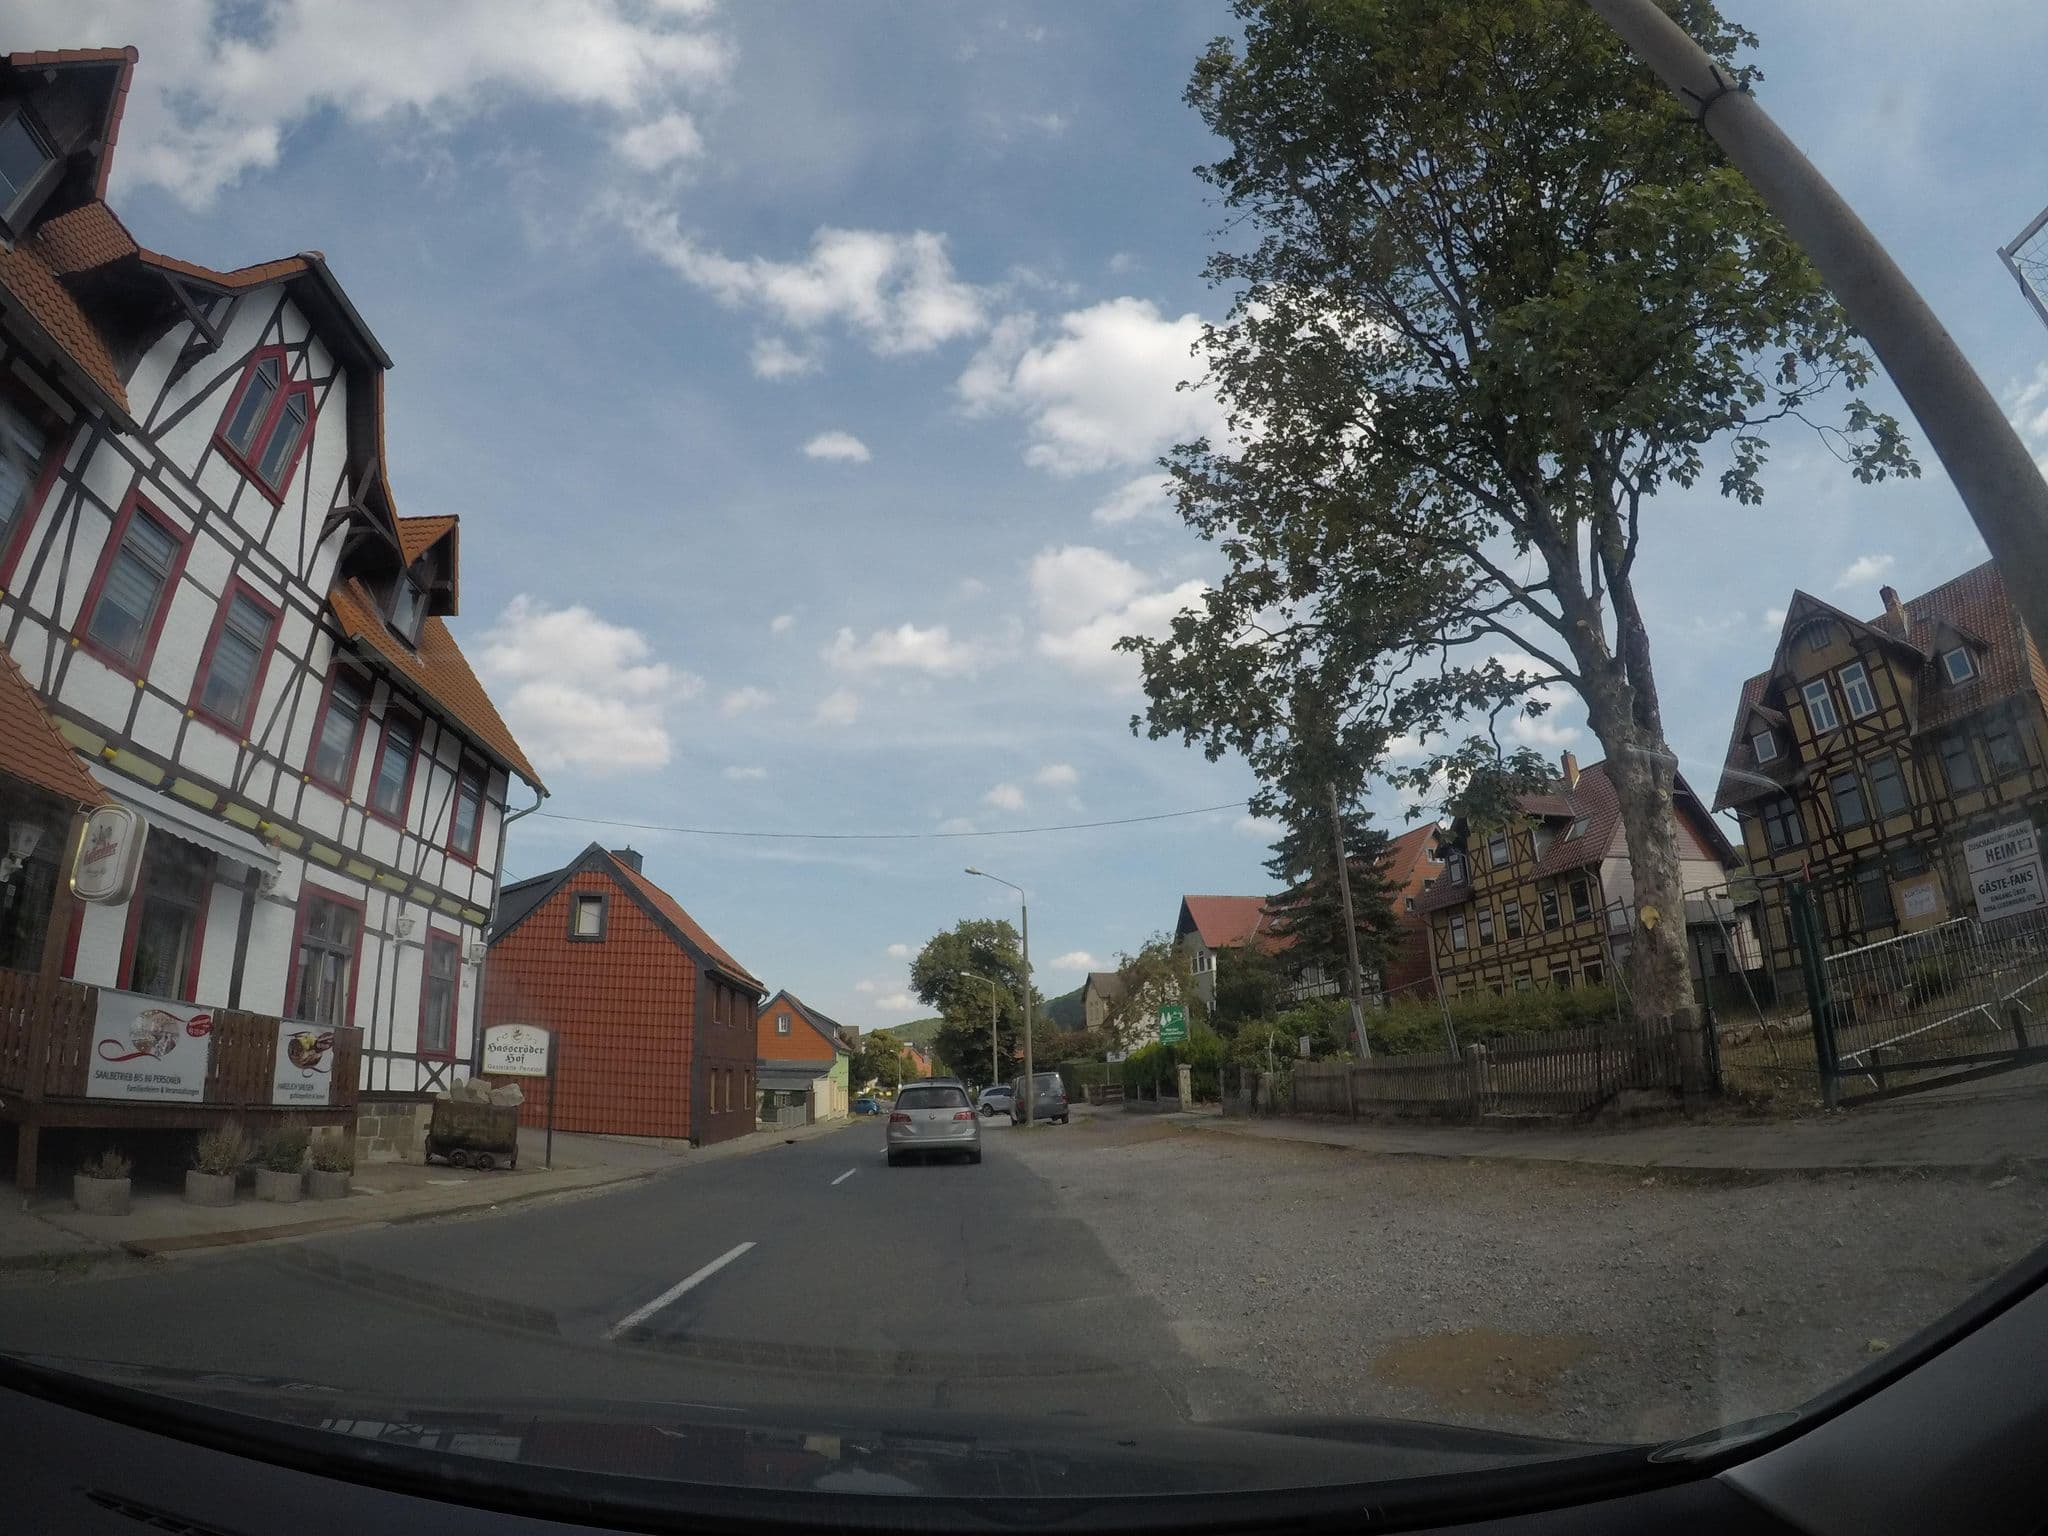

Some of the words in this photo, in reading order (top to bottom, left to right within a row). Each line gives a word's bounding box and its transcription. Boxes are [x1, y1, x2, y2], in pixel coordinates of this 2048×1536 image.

[1985, 841, 2018, 863] HEIM
[1978, 870, 2034, 895] GÄSTE-FANS
[487, 1043, 545, 1054] Hasseröder
[505, 1053, 525, 1064] Hof
[96, 1070, 133, 1082] SAALBETRIEB
[134, 1073, 144, 1083] BIS
